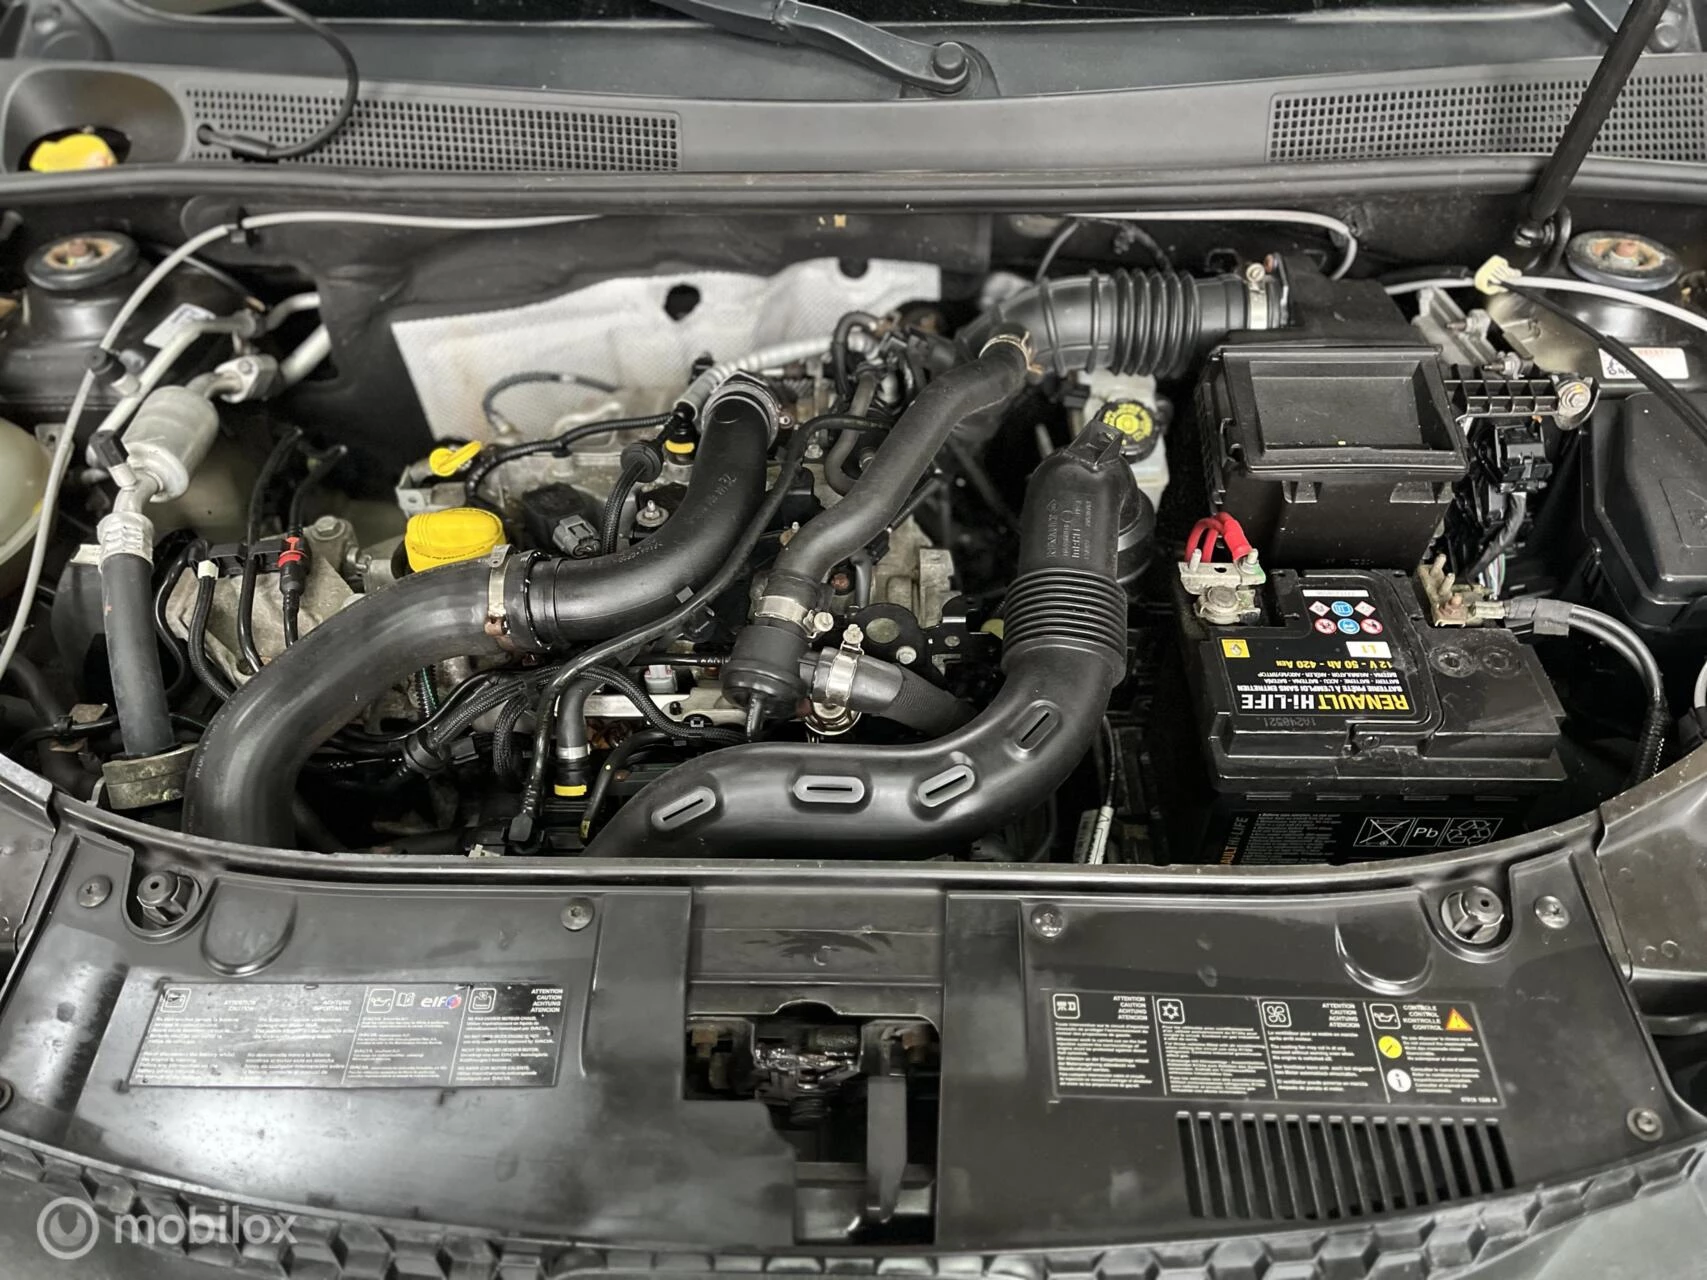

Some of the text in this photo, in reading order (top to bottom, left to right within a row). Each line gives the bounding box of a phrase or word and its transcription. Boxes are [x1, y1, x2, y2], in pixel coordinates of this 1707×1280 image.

[1297, 660, 1317, 668] 420
[1327, 660, 1341, 668] Ah
[1344, 660, 1358, 668] 50
[1369, 660, 1377, 668] V
[1379, 660, 1392, 668] 12
[1241, 694, 1409, 710] RENAULT Hi-LIFE
[1412, 826, 1440, 839] Pb
[420, 996, 448, 1008] elf
